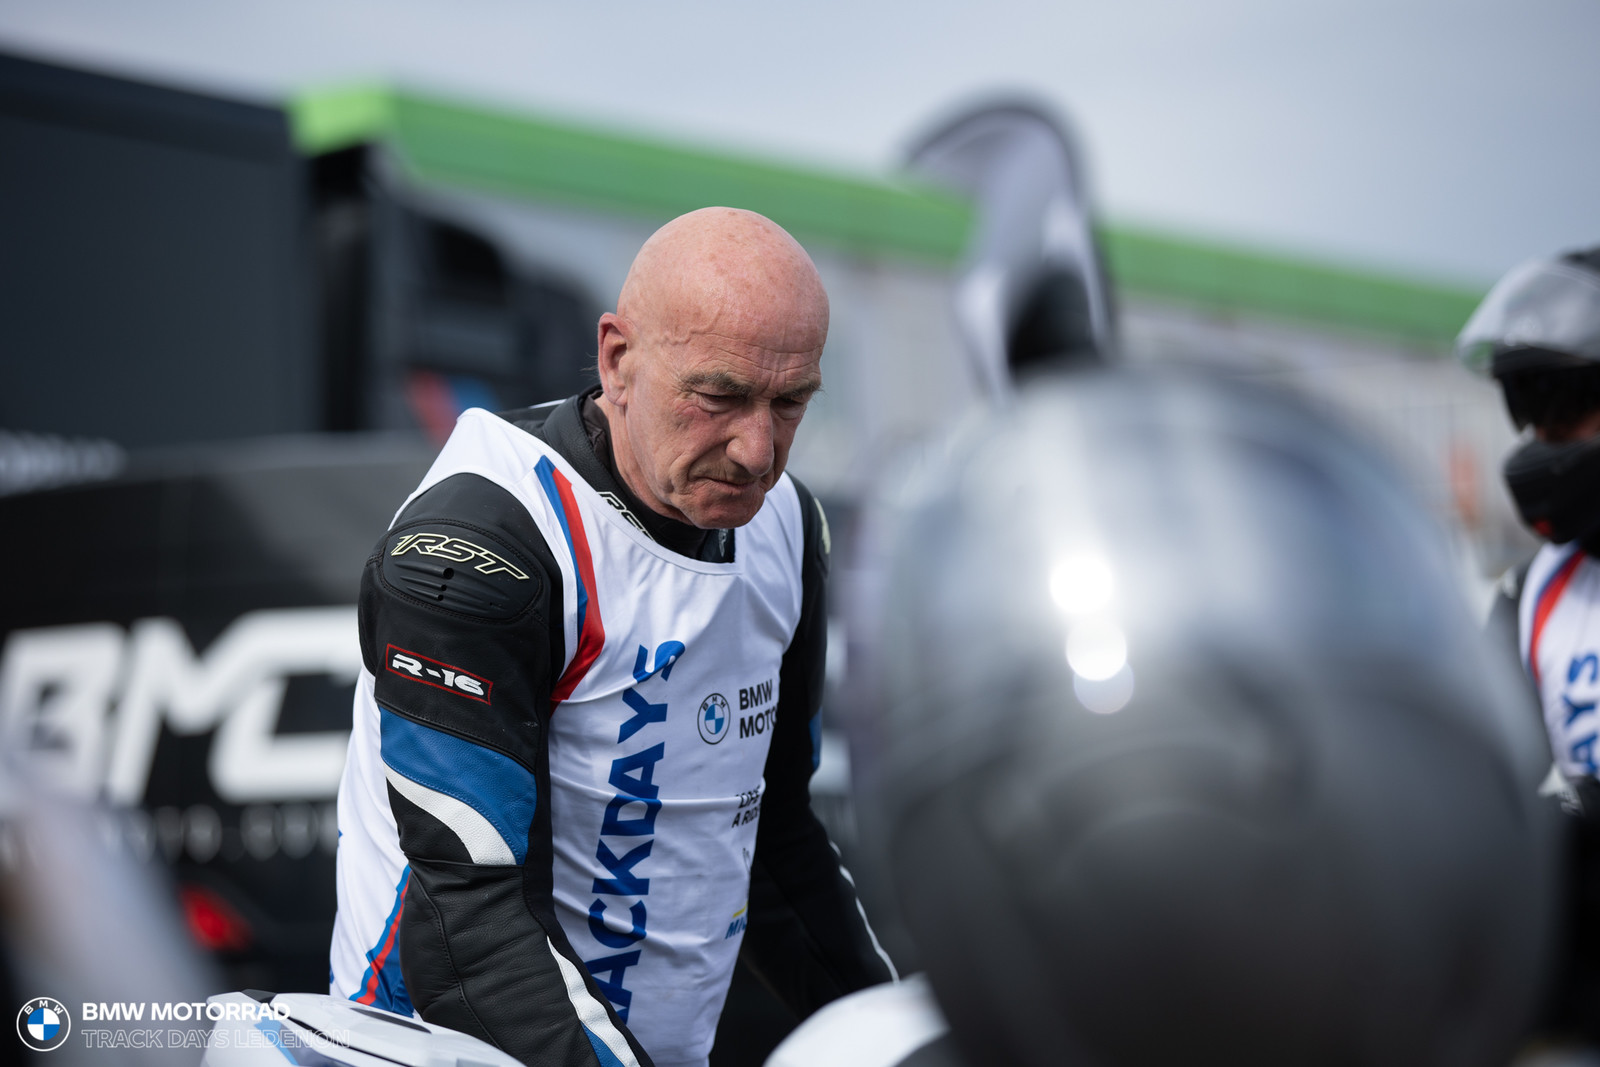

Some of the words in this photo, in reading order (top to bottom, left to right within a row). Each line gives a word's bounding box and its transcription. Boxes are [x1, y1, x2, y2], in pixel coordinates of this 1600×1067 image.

[391, 533, 529, 580] RST
[392, 653, 484, 696] R-16
[739, 679, 773, 711] BMW
[583, 640, 686, 1026] ACKDAYS
